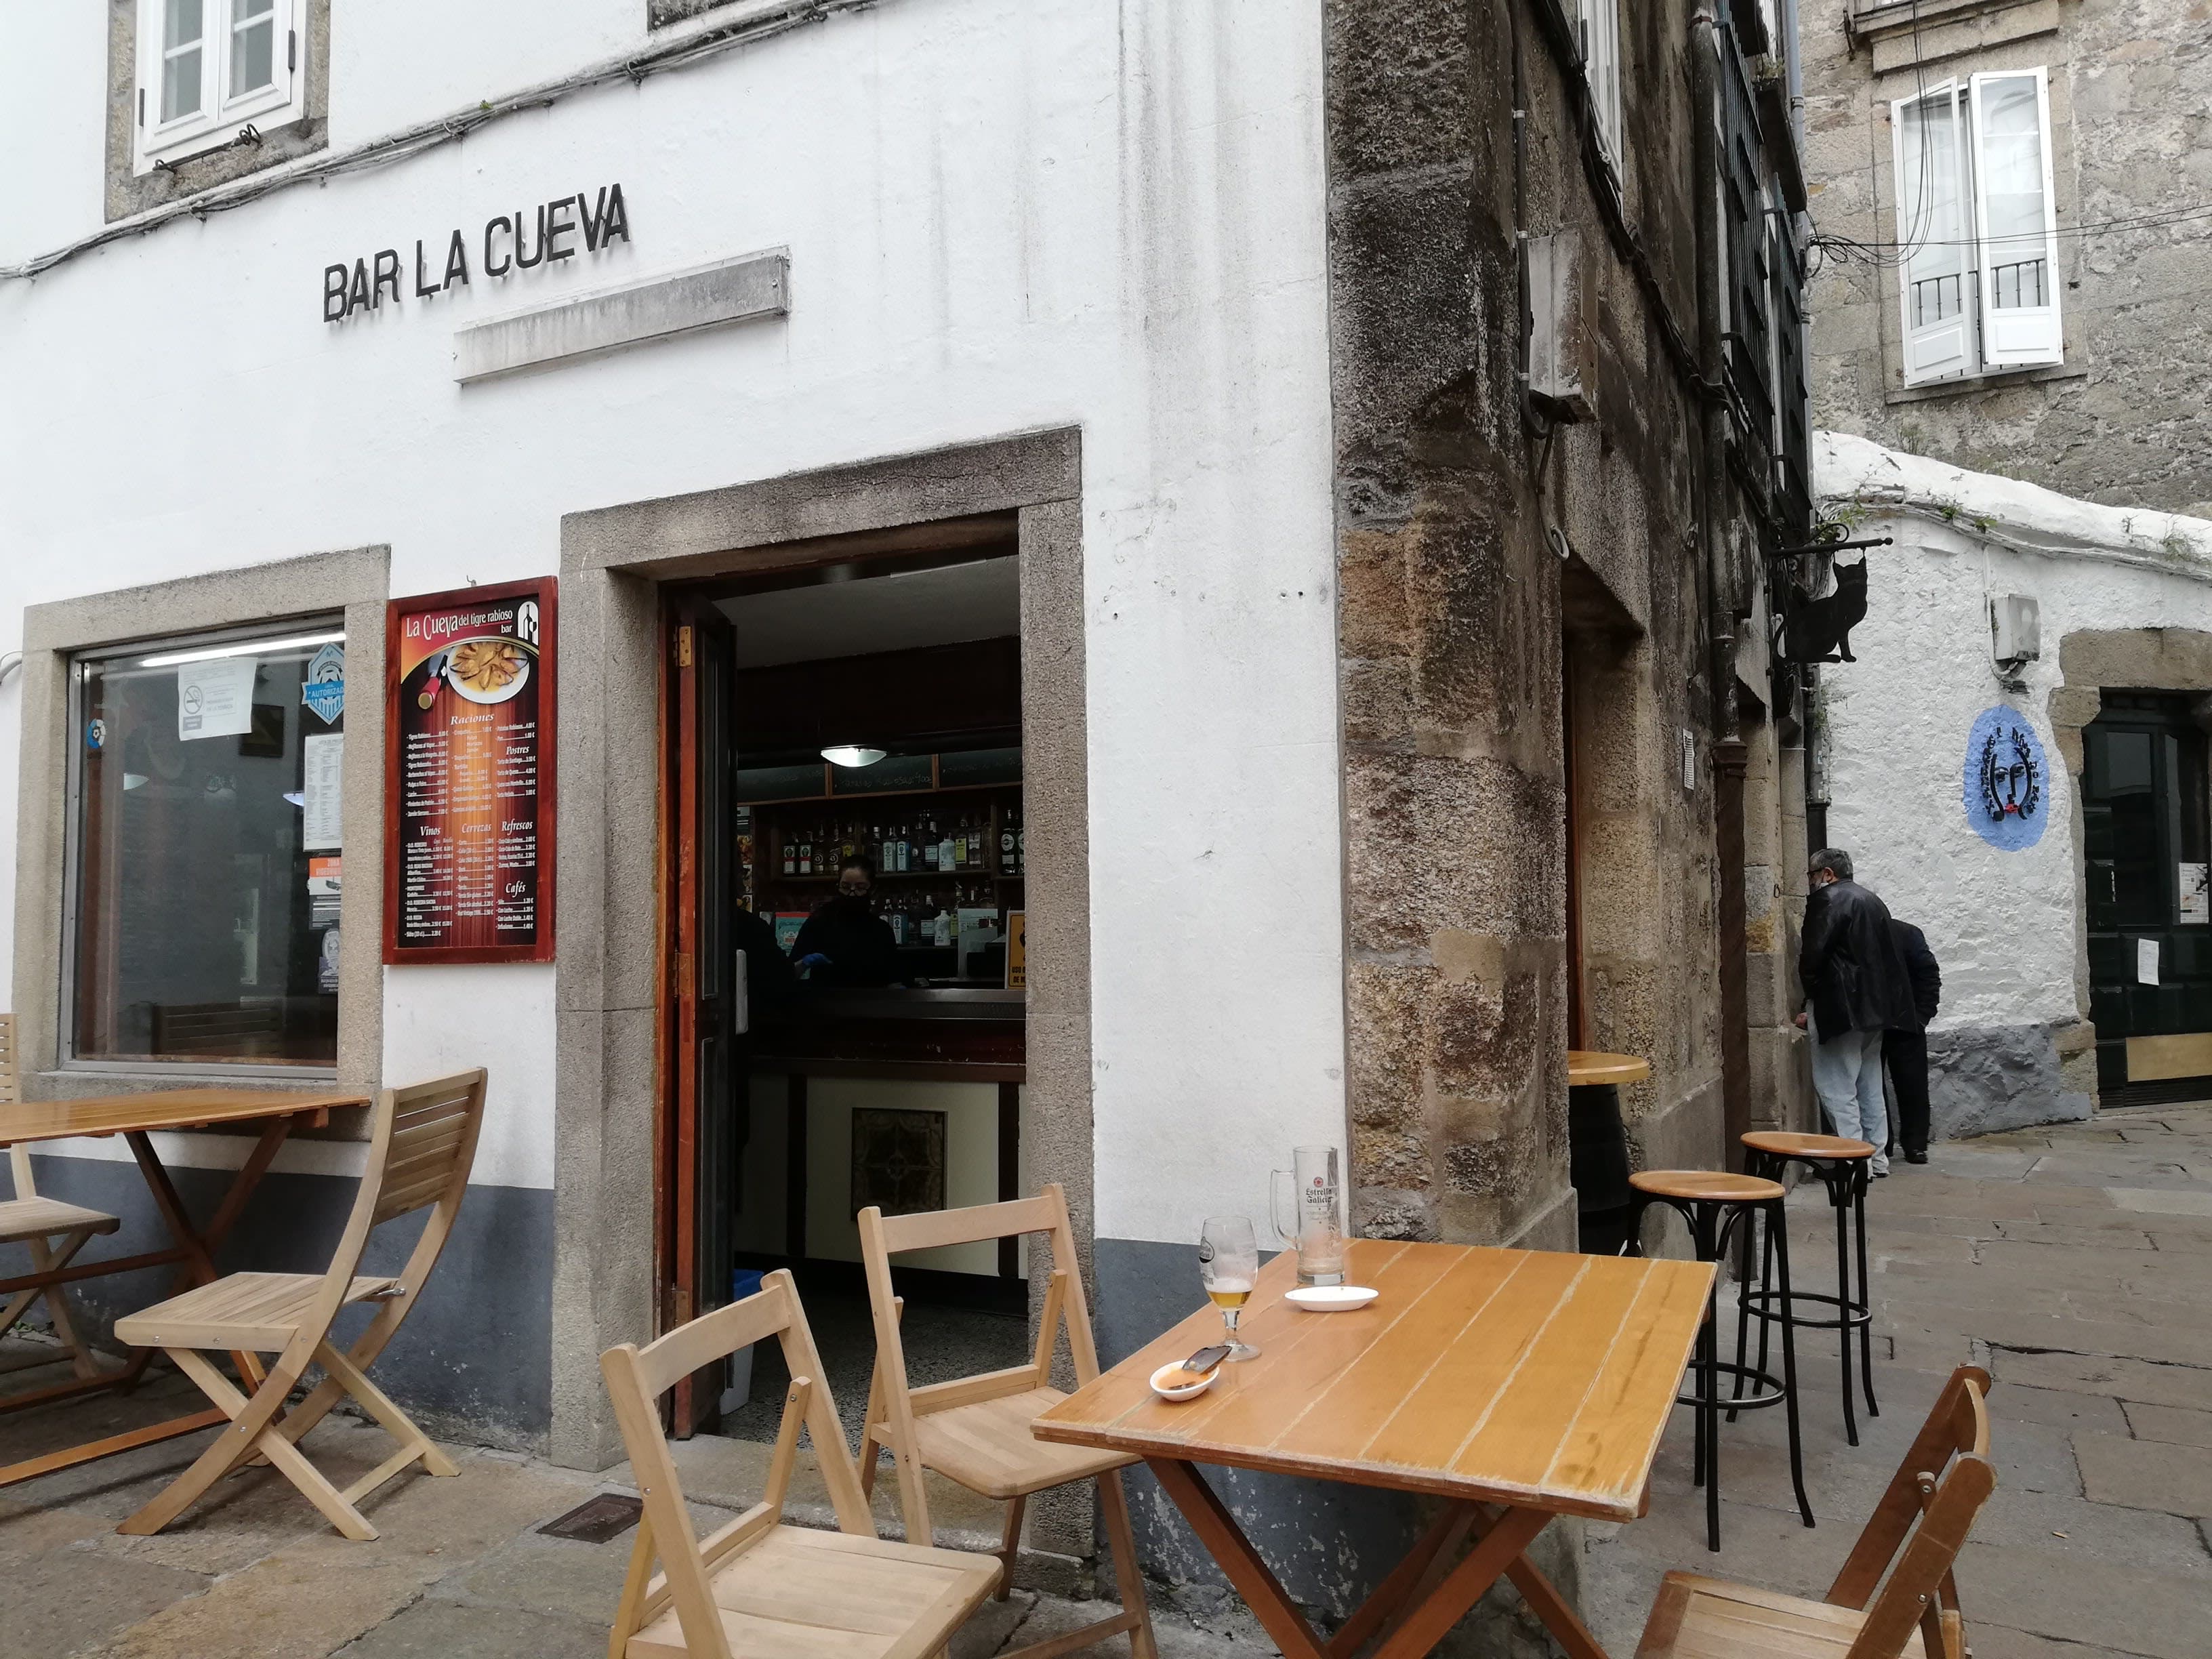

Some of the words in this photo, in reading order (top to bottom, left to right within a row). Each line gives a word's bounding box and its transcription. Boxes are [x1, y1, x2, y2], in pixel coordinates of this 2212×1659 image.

[324, 248, 399, 323] BAR
[415, 229, 469, 298] LA
[485, 183, 631, 277] CUEVA
[407, 617, 420, 638] La
[424, 615, 458, 640] Cueva
[458, 614, 469, 627] del
[470, 613, 486, 627] tigre
[487, 609, 512, 622] rabioso
[501, 625, 512, 634] bar
[450, 714, 495, 725] Raciones
[506, 746, 529, 755] Postres
[420, 826, 441, 836] Vinos
[462, 823, 491, 833] Cervezas
[501, 818, 533, 836] Refrescos
[506, 880, 526, 898] Cafés
